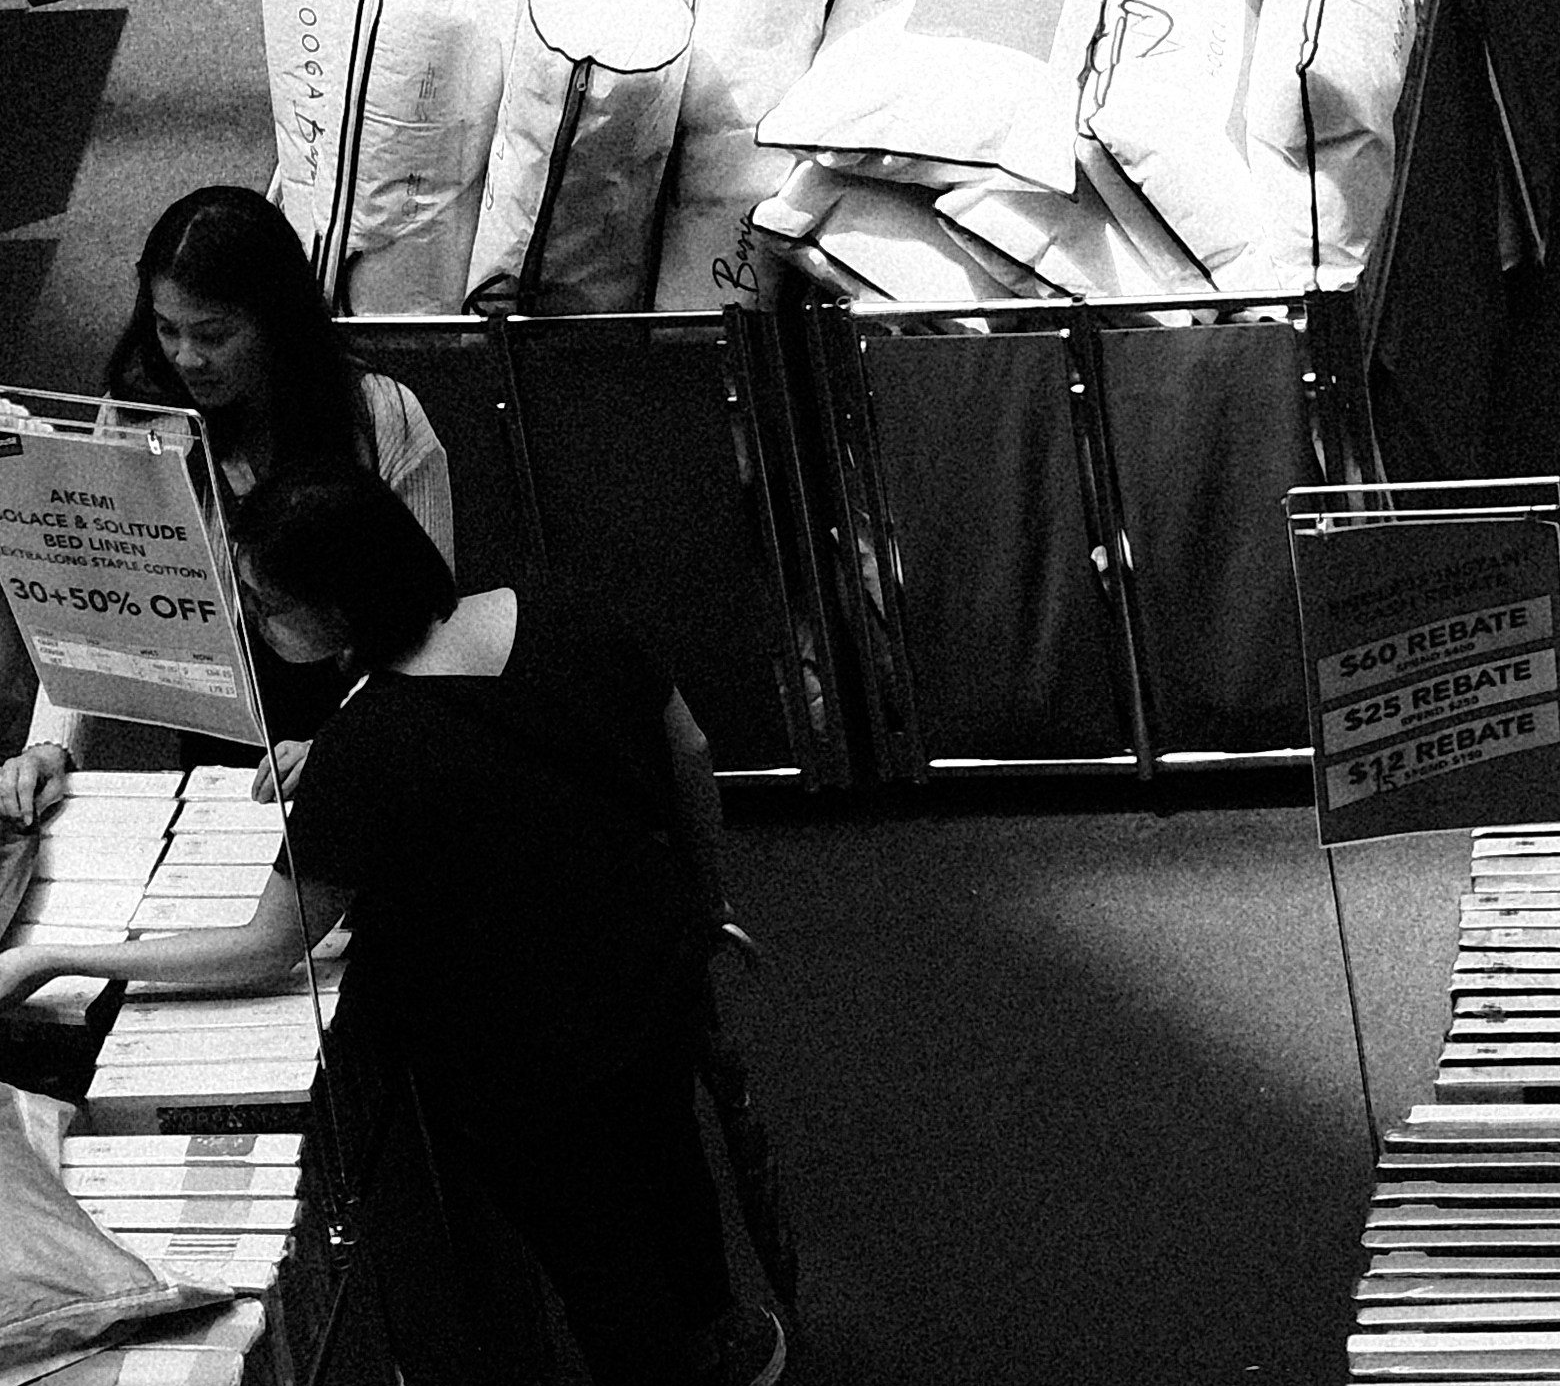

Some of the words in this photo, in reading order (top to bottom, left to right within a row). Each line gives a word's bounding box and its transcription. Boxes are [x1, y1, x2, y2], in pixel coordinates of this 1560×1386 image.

[51, 489, 115, 511] AKEMI
[44, 534, 83, 549] BED
[89, 537, 146, 557] LINEN
[75, 515, 87, 529] &
[93, 518, 187, 541] SOLITUDE
[92, 556, 140, 572] STAPLE
[144, 564, 207, 580] COTTON)
[10, 578, 142, 616] 30+50%
[150, 594, 216, 623] OFF
[1339, 642, 1397, 678] $60
[1407, 606, 1528, 655] REBATE
[1343, 696, 1401, 732] $25
[1411, 659, 1533, 711] REBATE
[1348, 750, 1406, 785] $12
[1415, 712, 1536, 764] REBATE
